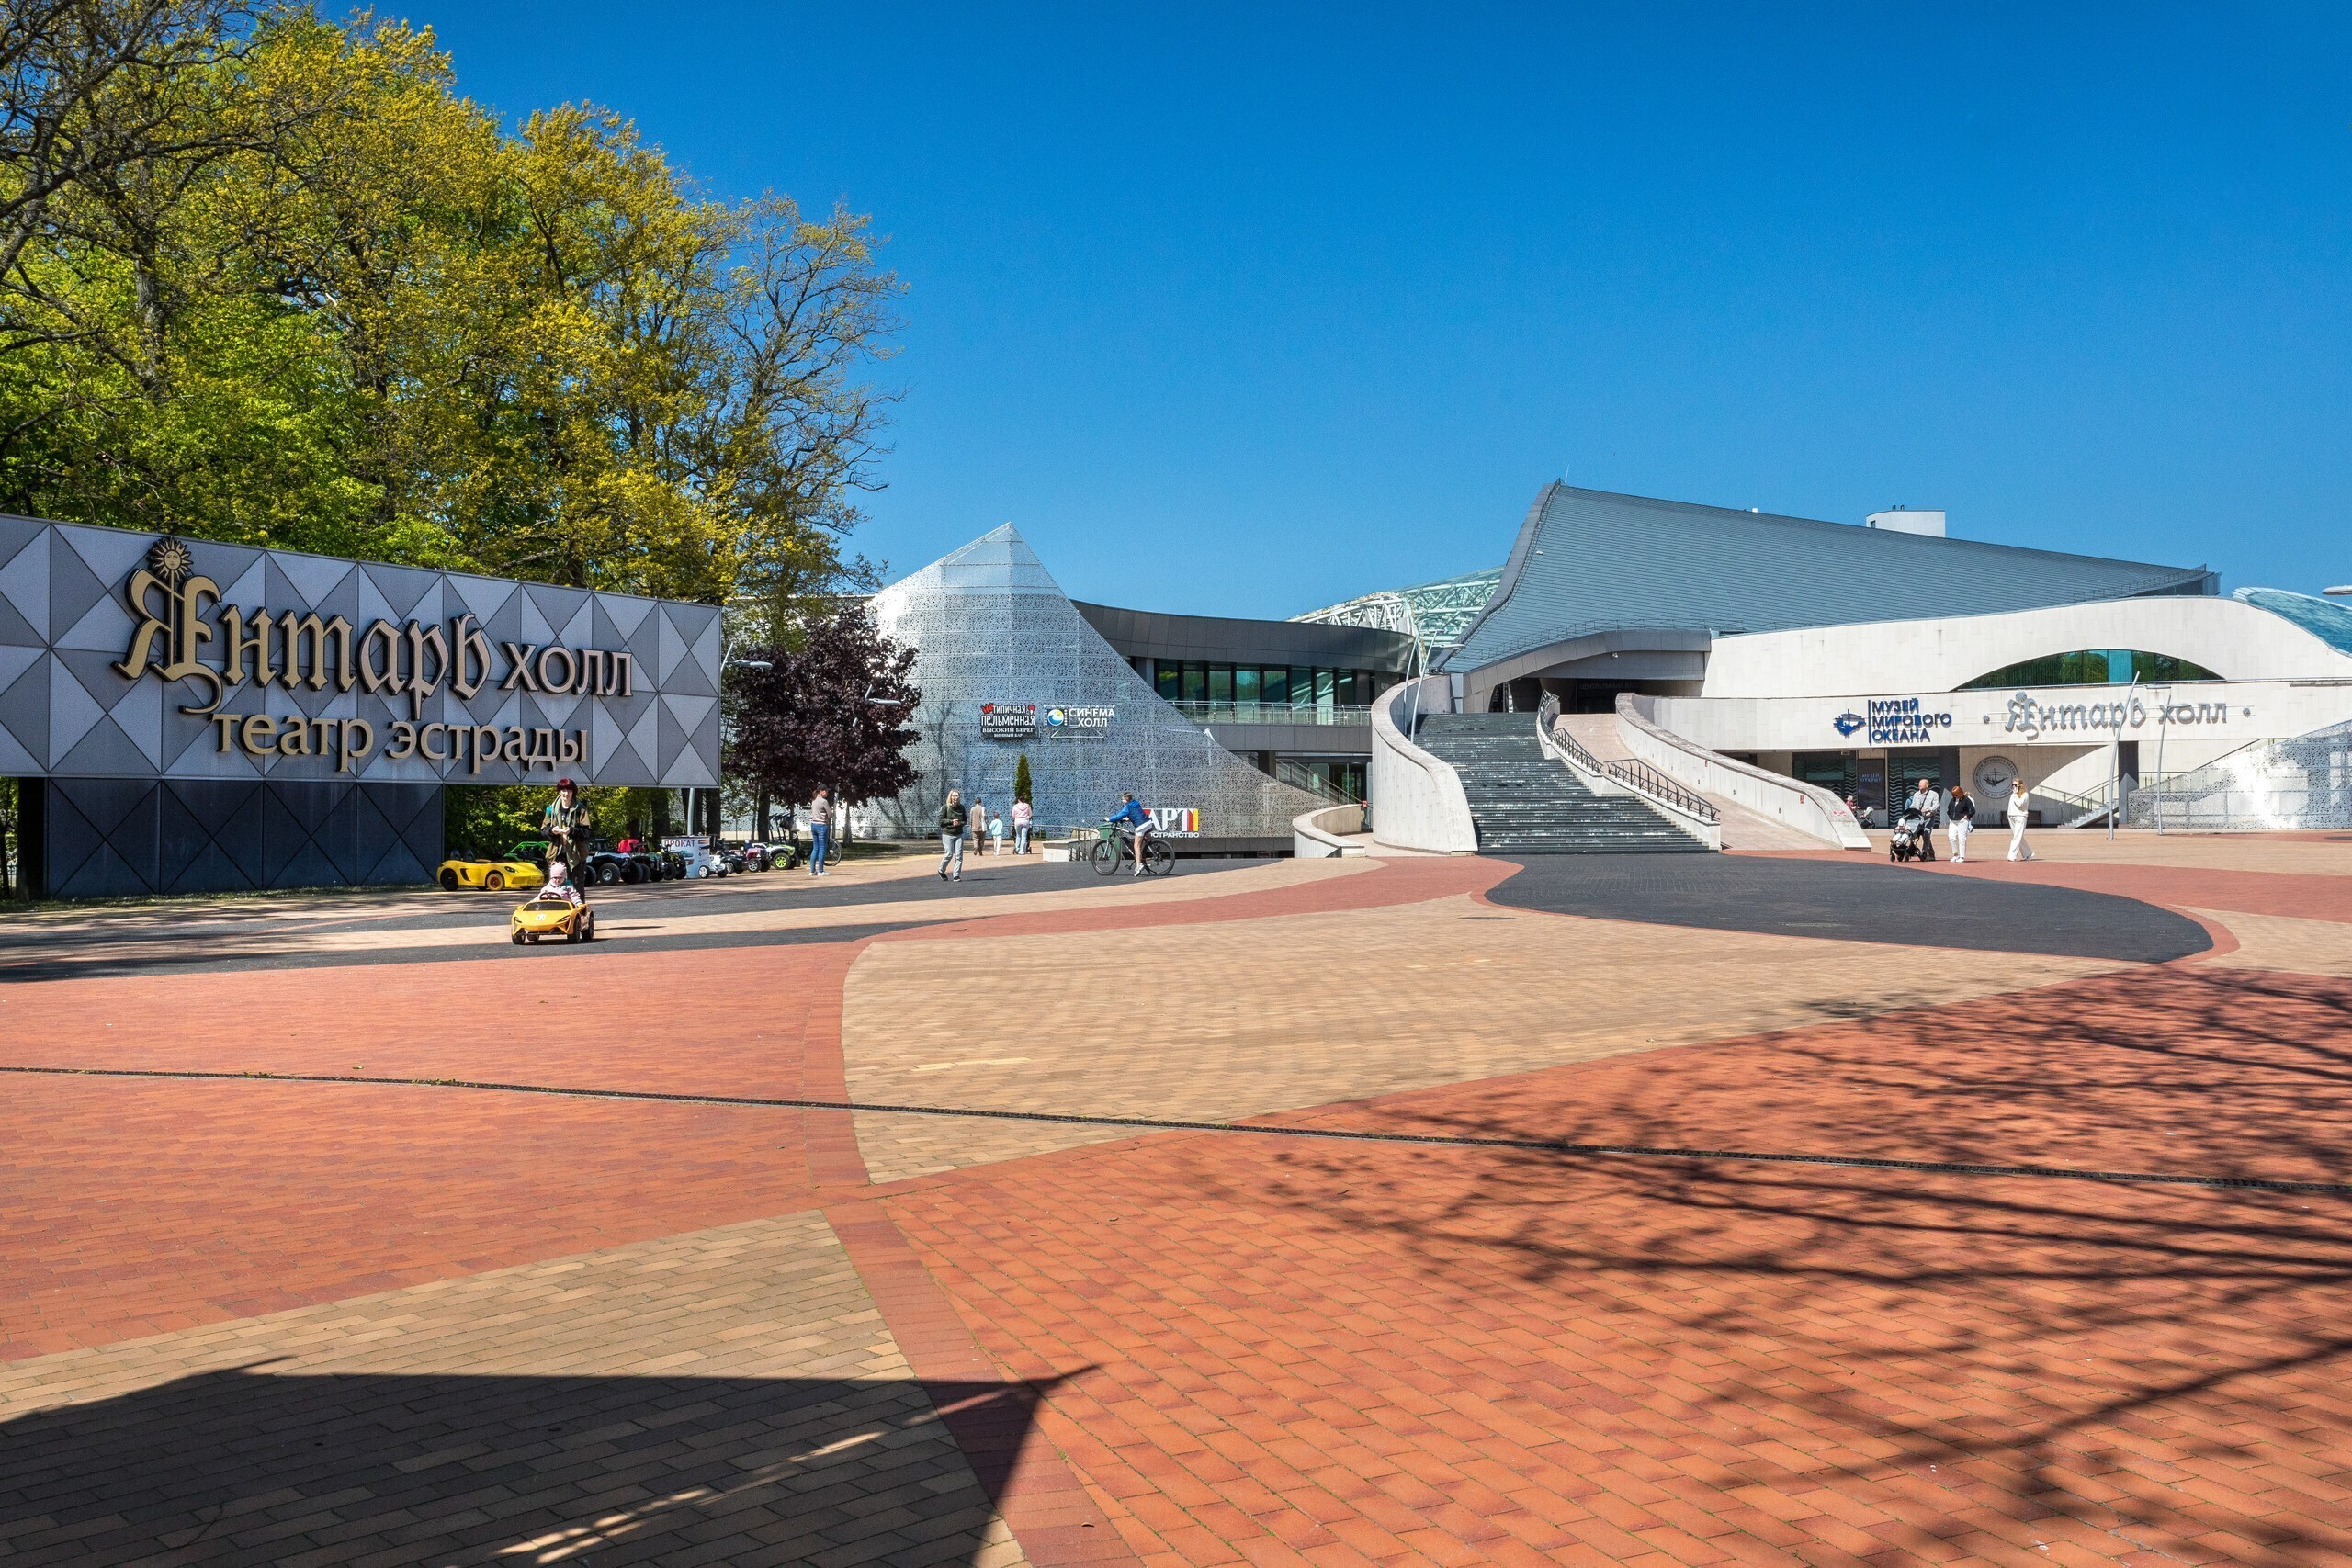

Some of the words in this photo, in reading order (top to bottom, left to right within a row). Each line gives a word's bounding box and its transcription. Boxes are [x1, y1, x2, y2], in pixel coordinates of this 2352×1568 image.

[111, 566, 492, 721] Янтарь
[502, 641, 634, 698] холл
[1069, 708, 1115, 717] СИНЕМА
[1871, 698, 1919, 715] МУЗЕЙ
[1078, 717, 1108, 728] ХОЛЛ
[1871, 713, 1952, 730] МИРОВОГО
[2005, 696, 2147, 741] Янтарь
[210, 712, 374, 772] театр
[385, 720, 588, 775] эстрады
[1871, 728, 1931, 744] ОКЕАНА
